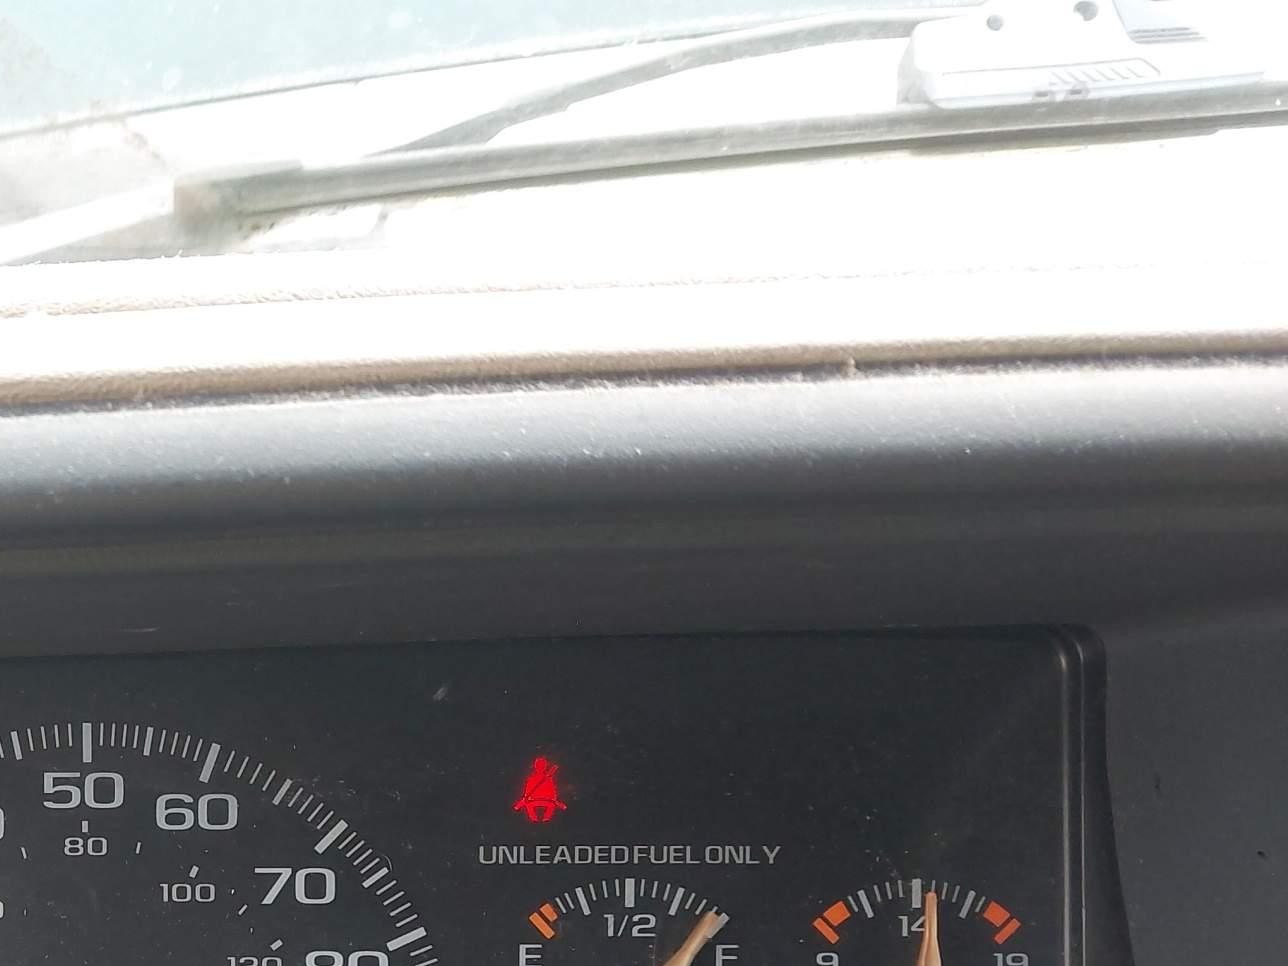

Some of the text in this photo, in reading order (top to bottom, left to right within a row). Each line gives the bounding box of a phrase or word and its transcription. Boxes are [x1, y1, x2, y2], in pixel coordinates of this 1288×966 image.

[43, 772, 124, 809] 50
[155, 793, 238, 831] 60
[64, 837, 108, 856] 80
[478, 845, 781, 865] UNLEADED FUEL ONLY
[159, 883, 216, 902] 100
[254, 867, 336, 905] 70
[603, 914, 657, 937] 1/2
